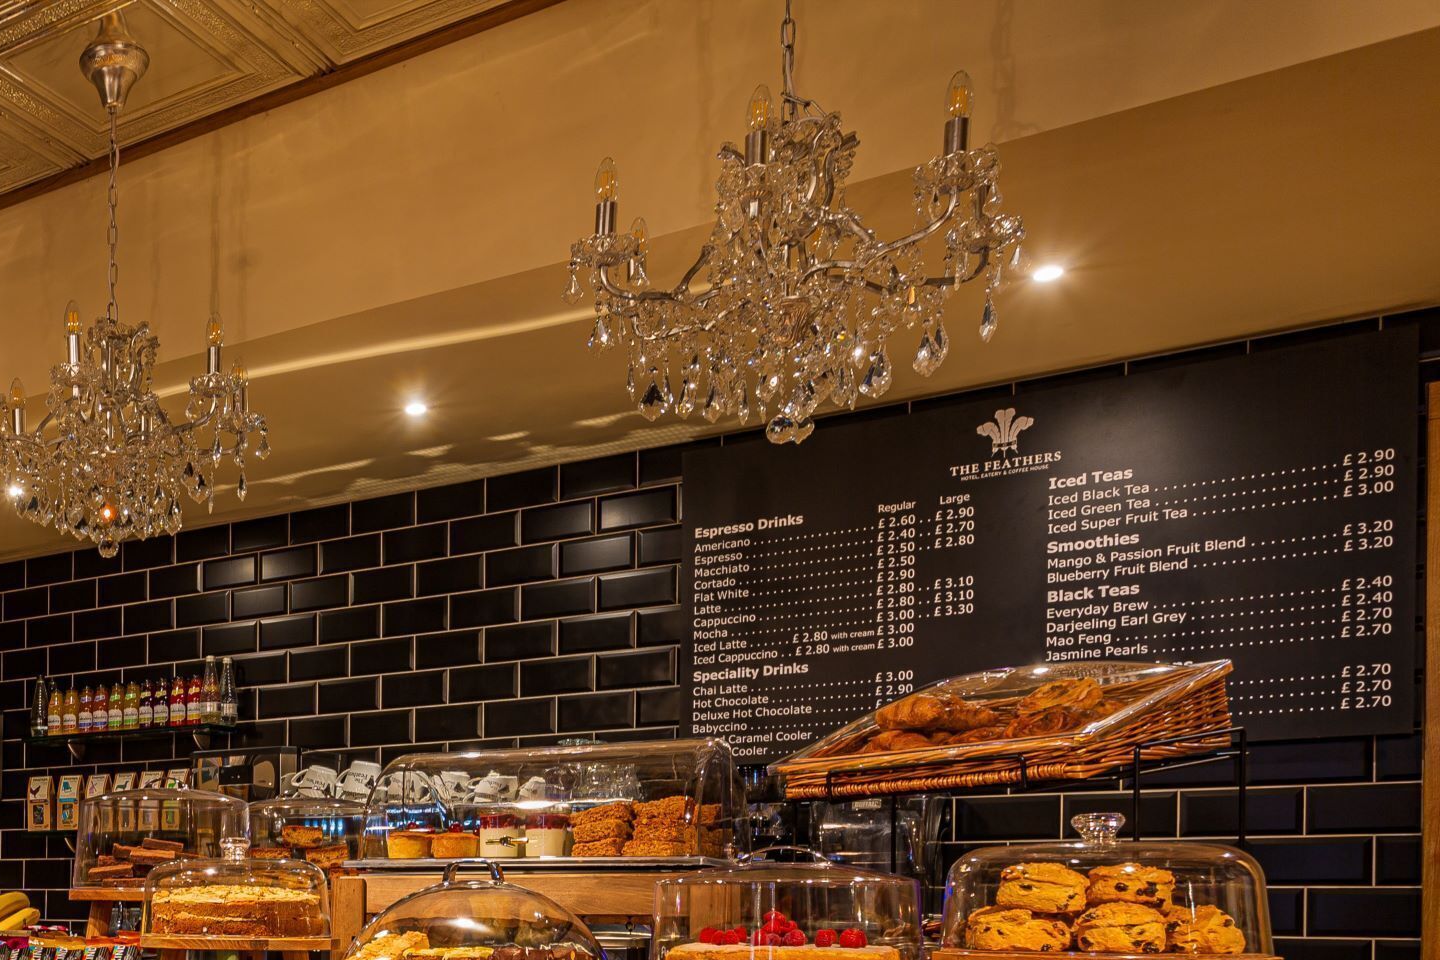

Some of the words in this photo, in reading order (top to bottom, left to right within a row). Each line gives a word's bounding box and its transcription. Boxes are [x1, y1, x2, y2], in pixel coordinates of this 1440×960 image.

[950, 464, 979, 476] THE
[984, 450, 1062, 472] FEATHERS
[981, 471, 1001, 479] EATERY
[1049, 492, 1078, 505] Iced
[1083, 487, 1120, 501] Black
[1124, 484, 1149, 495] Tea
[1358, 448, 1394, 464] 2.90
[1048, 506, 1076, 520] Iced
[1081, 503, 1121, 515] Green
[1126, 499, 1150, 509] Tea
[1359, 464, 1394, 479] 2.90
[1049, 473, 1086, 489] Iced
[1092, 469, 1133, 483] Teas
[878, 501, 916, 513] Regular
[940, 494, 970, 504] Large
[1048, 521, 1076, 534] Iced
[1081, 517, 1121, 530] Super
[1126, 511, 1158, 524] Fruit
[1162, 509, 1187, 519] Tea
[1358, 481, 1394, 495] 3.00
[694, 539, 750, 553] Americano
[889, 514, 915, 527] 2.60
[947, 507, 974, 519] 2.90
[695, 523, 754, 539] Espresso
[758, 515, 803, 529] Drinks
[695, 553, 742, 565] Espresso
[888, 528, 915, 541] 2.40
[946, 520, 974, 533] 2.70
[695, 564, 749, 578] Macchiato
[888, 542, 915, 554] 2.50
[946, 534, 974, 547] 2.80
[1047, 533, 1139, 553] Smoothies
[1048, 557, 1092, 569] Mango
[1096, 553, 1106, 563] &
[1111, 548, 1162, 562] Passion
[1167, 543, 1200, 555] Fruit
[1205, 536, 1245, 551] Blend
[1358, 520, 1393, 534] 3.20
[694, 577, 736, 590] Cortado
[888, 555, 915, 567] 2.50
[1048, 569, 1109, 583] Blueberry
[1114, 564, 1145, 576] Fruit
[1150, 558, 1187, 572] Blend
[1359, 536, 1393, 550] 3.20
[694, 592, 714, 603] Flat
[717, 589, 749, 600] White
[888, 569, 915, 581] 2.90
[694, 605, 721, 615] Latte
[887, 582, 914, 594] 2.80
[945, 576, 973, 588] 3.10
[1047, 604, 1109, 618] Everyday
[1113, 601, 1148, 612] Brew
[1356, 575, 1392, 589] 2.40
[1048, 587, 1094, 603] Black
[1098, 585, 1139, 597] Teas
[694, 614, 756, 628] Cappuccino
[888, 596, 914, 608] 2.80
[946, 589, 974, 602] 3.10
[694, 629, 727, 640] Mocha
[887, 609, 914, 621] 3.00
[946, 603, 973, 615] 3.30
[1047, 618, 1116, 633] Darjeeling
[1121, 614, 1148, 626] Earl
[1153, 613, 1186, 623] Grey
[1357, 591, 1392, 605] 2.40
[694, 642, 716, 653] Iced
[720, 640, 747, 650] Latte
[803, 631, 827, 642] 2.80
[850, 630, 874, 638] cream
[888, 623, 914, 634] 3.00
[1047, 636, 1074, 647] Mao
[1079, 634, 1111, 644] Feng
[1357, 607, 1392, 620] 2.70
[694, 654, 715, 665] Iced
[718, 650, 778, 663] Cappuccino
[806, 644, 829, 655] 2.80
[888, 636, 913, 648] 3.00
[1045, 648, 1101, 661] Jasmine
[1106, 643, 1148, 656] Pearls
[1356, 623, 1391, 636] 2.70
[693, 667, 759, 683] Speciality
[763, 663, 808, 676] Drinks
[693, 686, 716, 696] Chai
[720, 684, 747, 694] Latte
[886, 670, 913, 681] 3.00
[1356, 663, 1391, 676] 2.70
[693, 699, 711, 708] Hot
[715, 695, 768, 707] Chocolate
[886, 684, 913, 695] 2.90
[1356, 679, 1391, 692] 2.70
[693, 711, 729, 721] Deluxe
[733, 709, 752, 718] Hot
[755, 705, 812, 717] Chocolate
[1356, 695, 1391, 708] 2.70
[693, 722, 747, 734] Babyccino
[729, 732, 772, 744] Caramel
[776, 731, 812, 741] Cooler
[732, 746, 768, 756] Cooler
